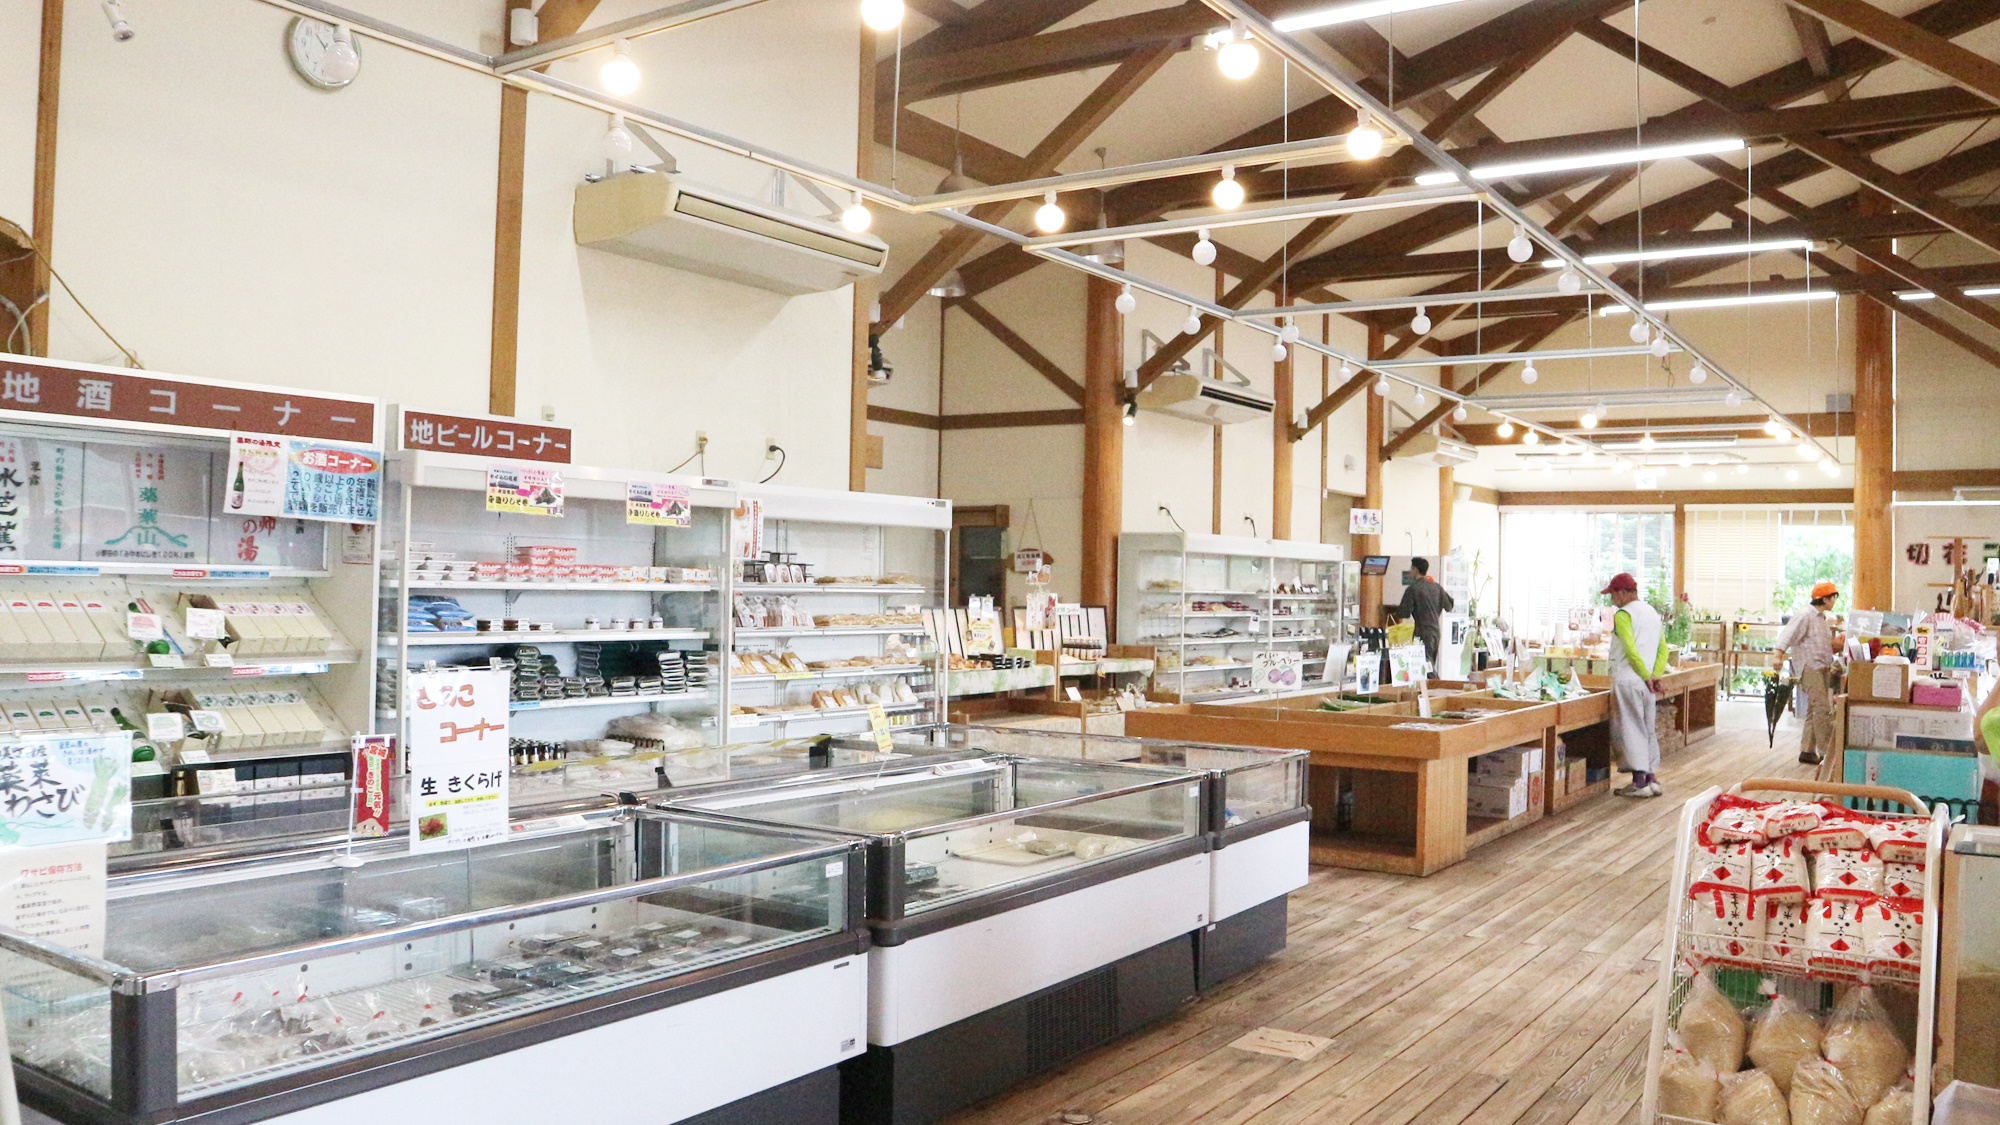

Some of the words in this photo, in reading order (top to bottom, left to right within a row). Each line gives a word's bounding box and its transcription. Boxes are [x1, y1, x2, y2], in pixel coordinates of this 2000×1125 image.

[2, 370, 357, 426] 地酒コーナー
[410, 419, 568, 455] 地ビールコーナー
[302, 451, 373, 470] お酒コーナー
[439, 717, 505, 743] コーナー
[420, 776, 438, 796] 生
[448, 771, 503, 793] きくらげ
[4, 784, 86, 818] わさび
[20, 863, 83, 877] ワサビ保存方法
